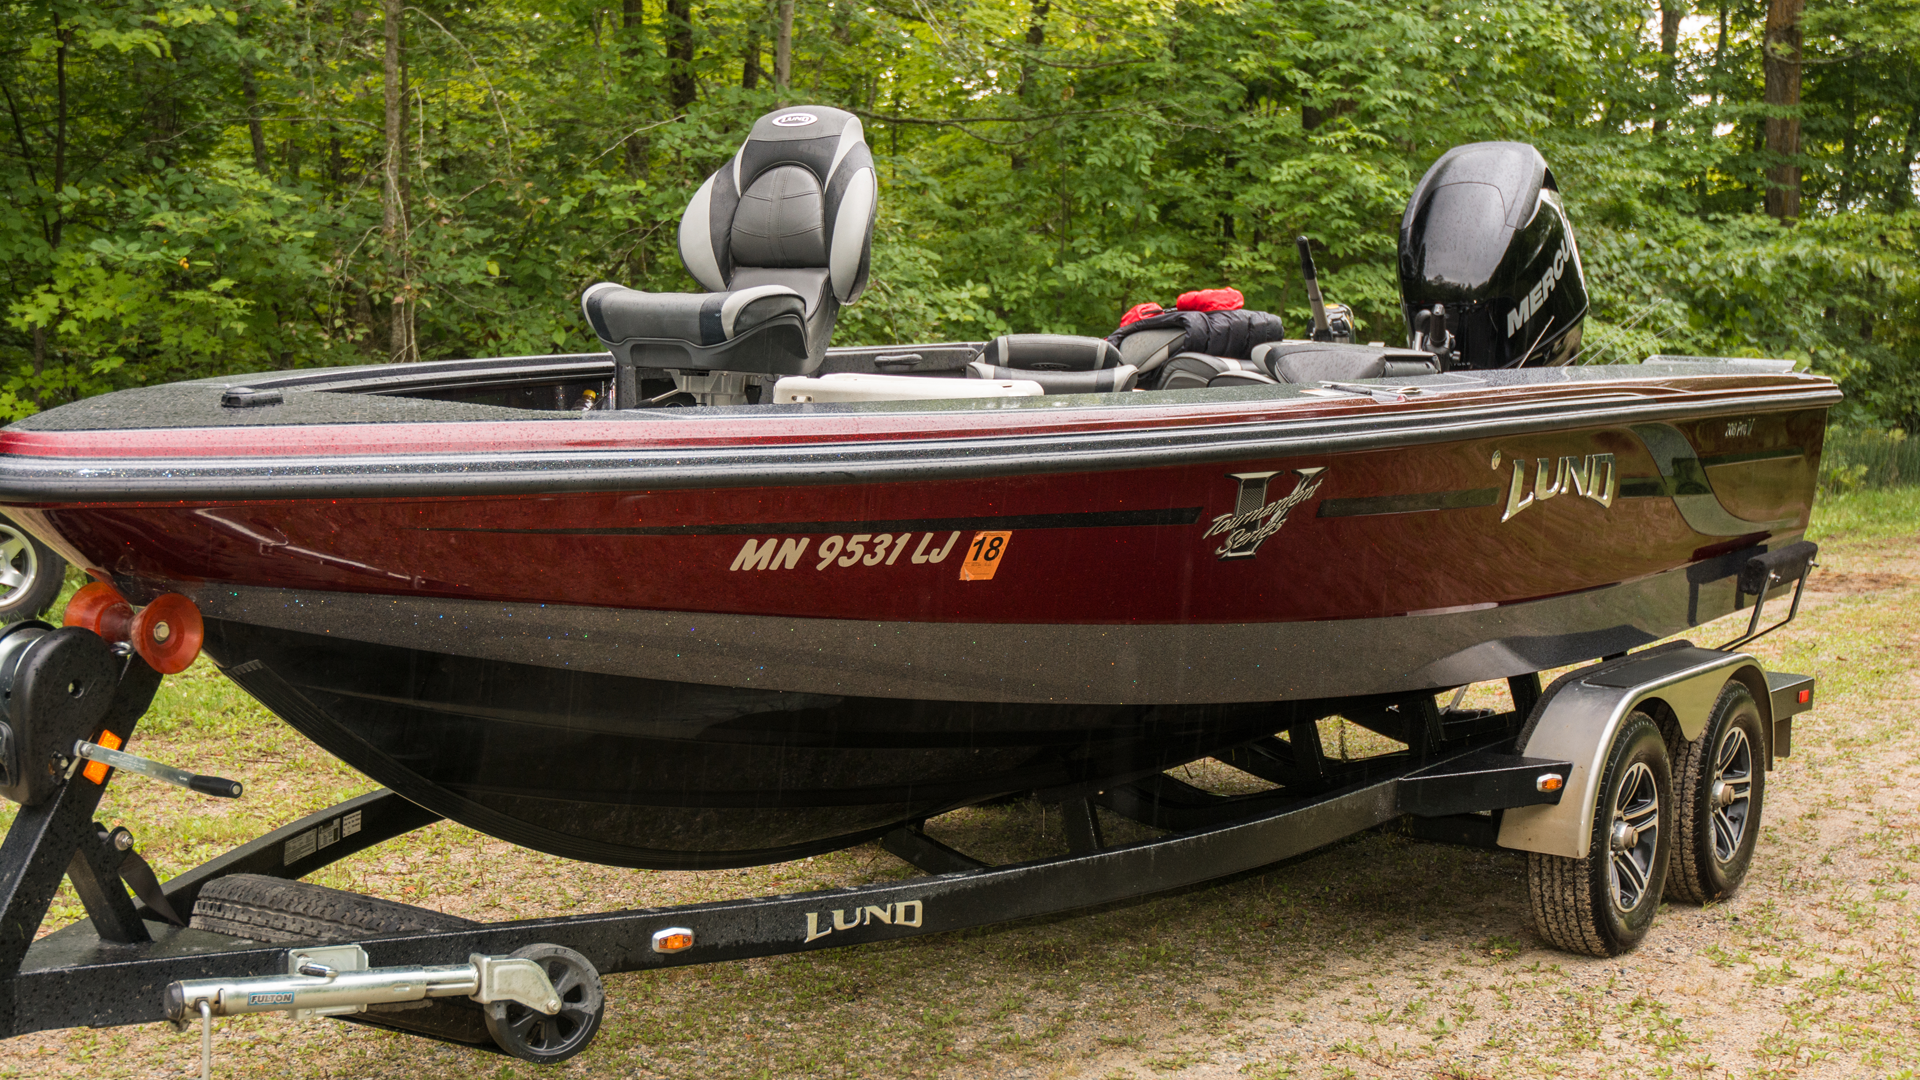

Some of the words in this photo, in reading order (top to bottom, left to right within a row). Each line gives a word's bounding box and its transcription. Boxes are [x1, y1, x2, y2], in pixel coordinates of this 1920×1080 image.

[779, 115, 811, 123] LUND
[1501, 453, 1616, 523] LUND
[1202, 477, 1324, 540] Tournament
[729, 537, 810, 571] MN
[816, 533, 912, 571] 9531
[911, 530, 961, 564] LJ
[972, 536, 1004, 562] 18
[1215, 518, 1288, 555] Series
[804, 900, 923, 943] LUND
[251, 994, 292, 1003] FULTON
